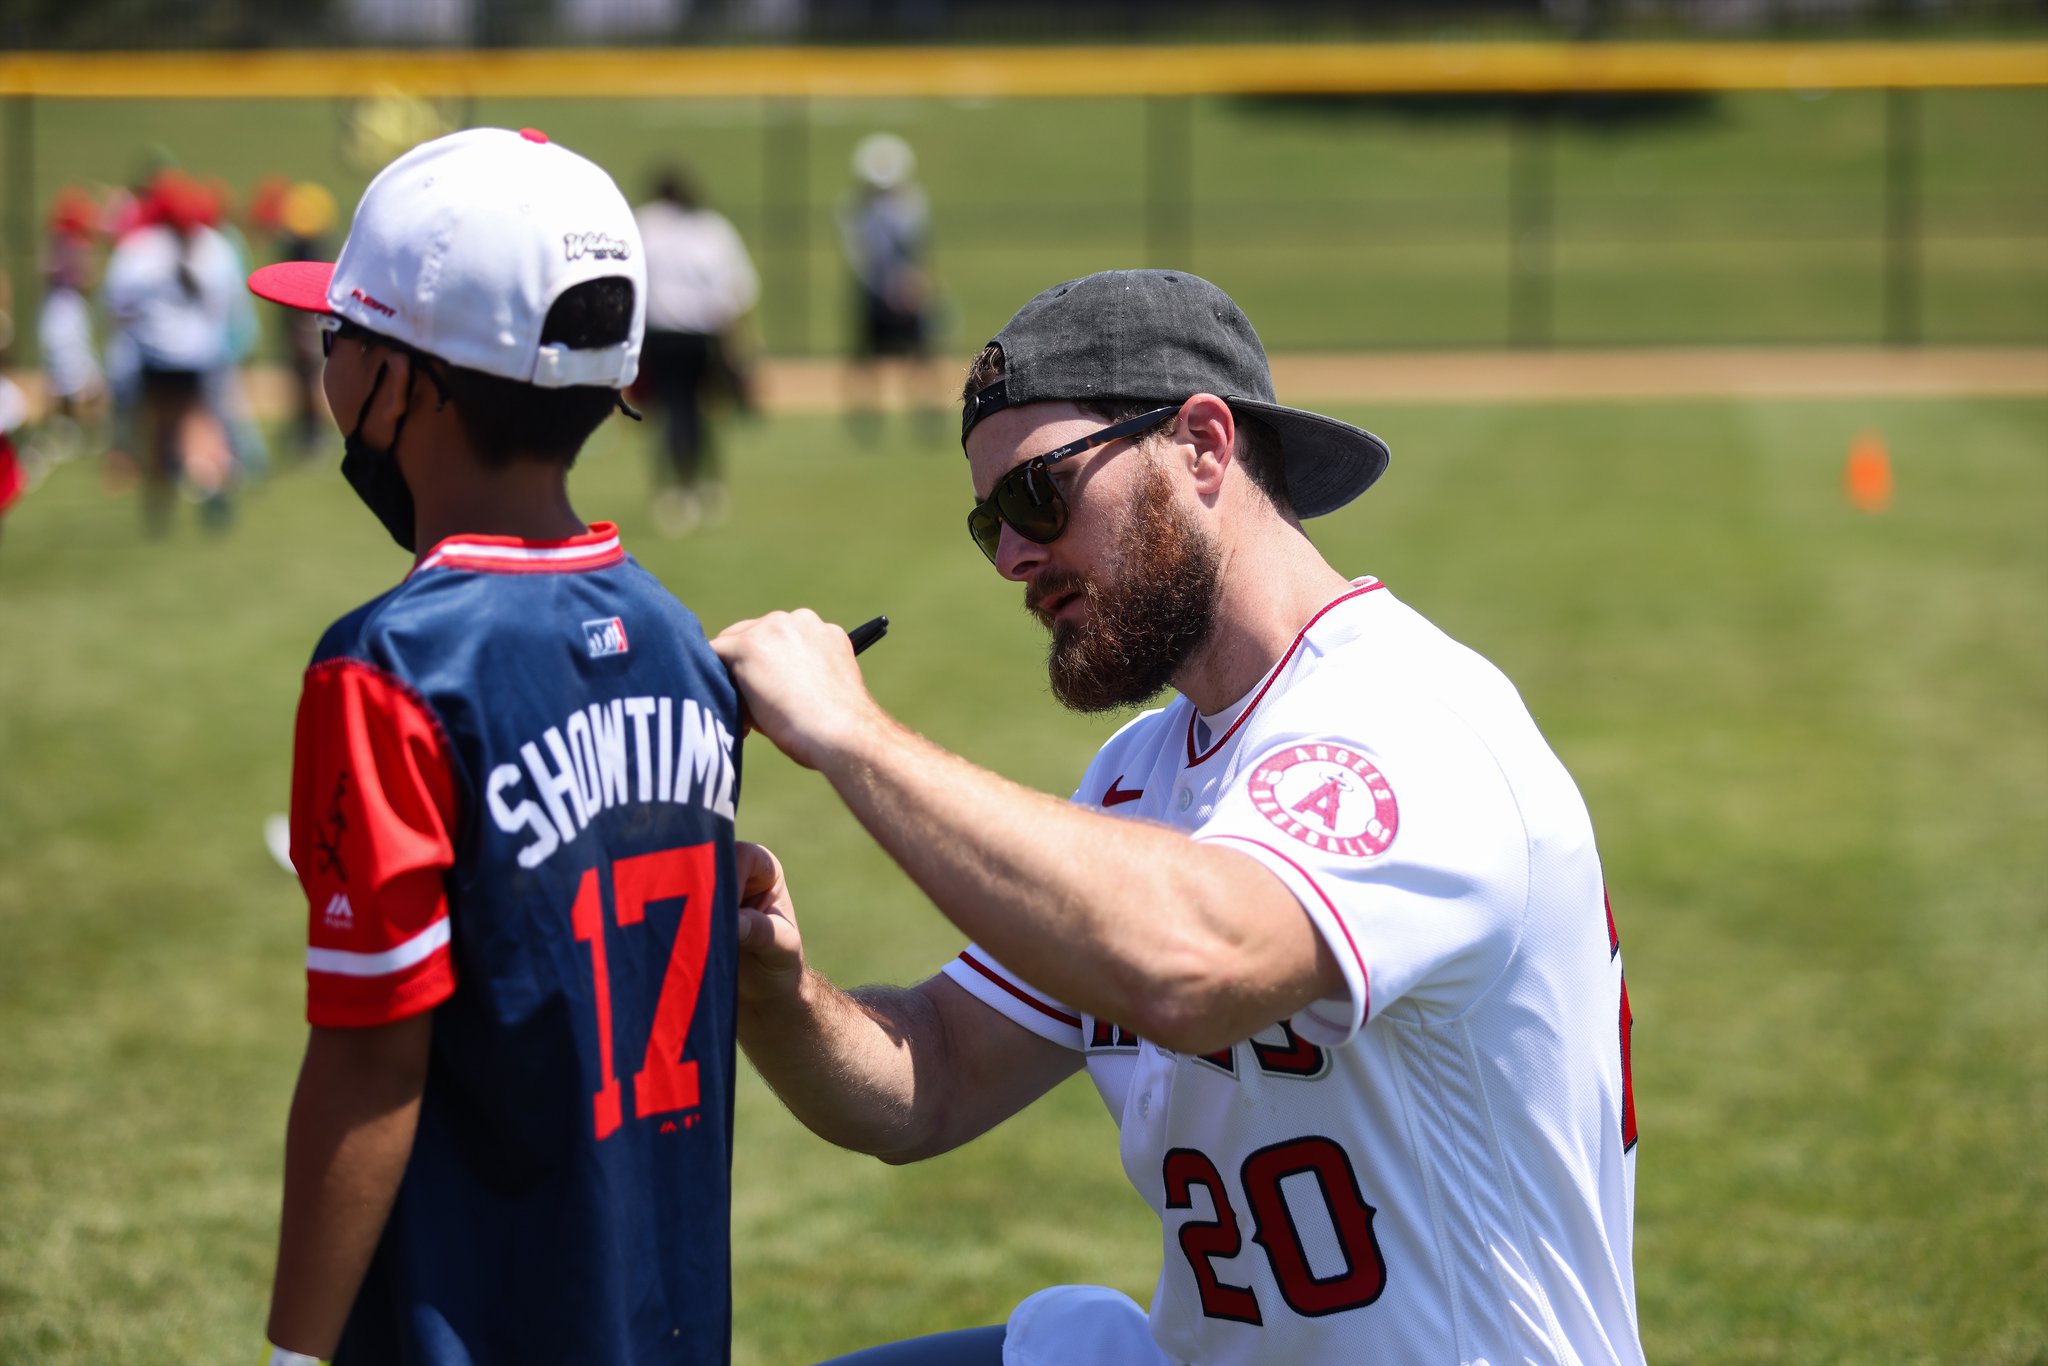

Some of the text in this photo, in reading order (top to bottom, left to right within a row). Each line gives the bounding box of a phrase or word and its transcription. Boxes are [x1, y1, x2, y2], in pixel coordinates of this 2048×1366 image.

[485, 695, 736, 869] SHOWTIME
[1295, 745, 1392, 801] ANGELS
[570, 841, 716, 1142] 17
[1163, 1135, 1387, 1326] 20
